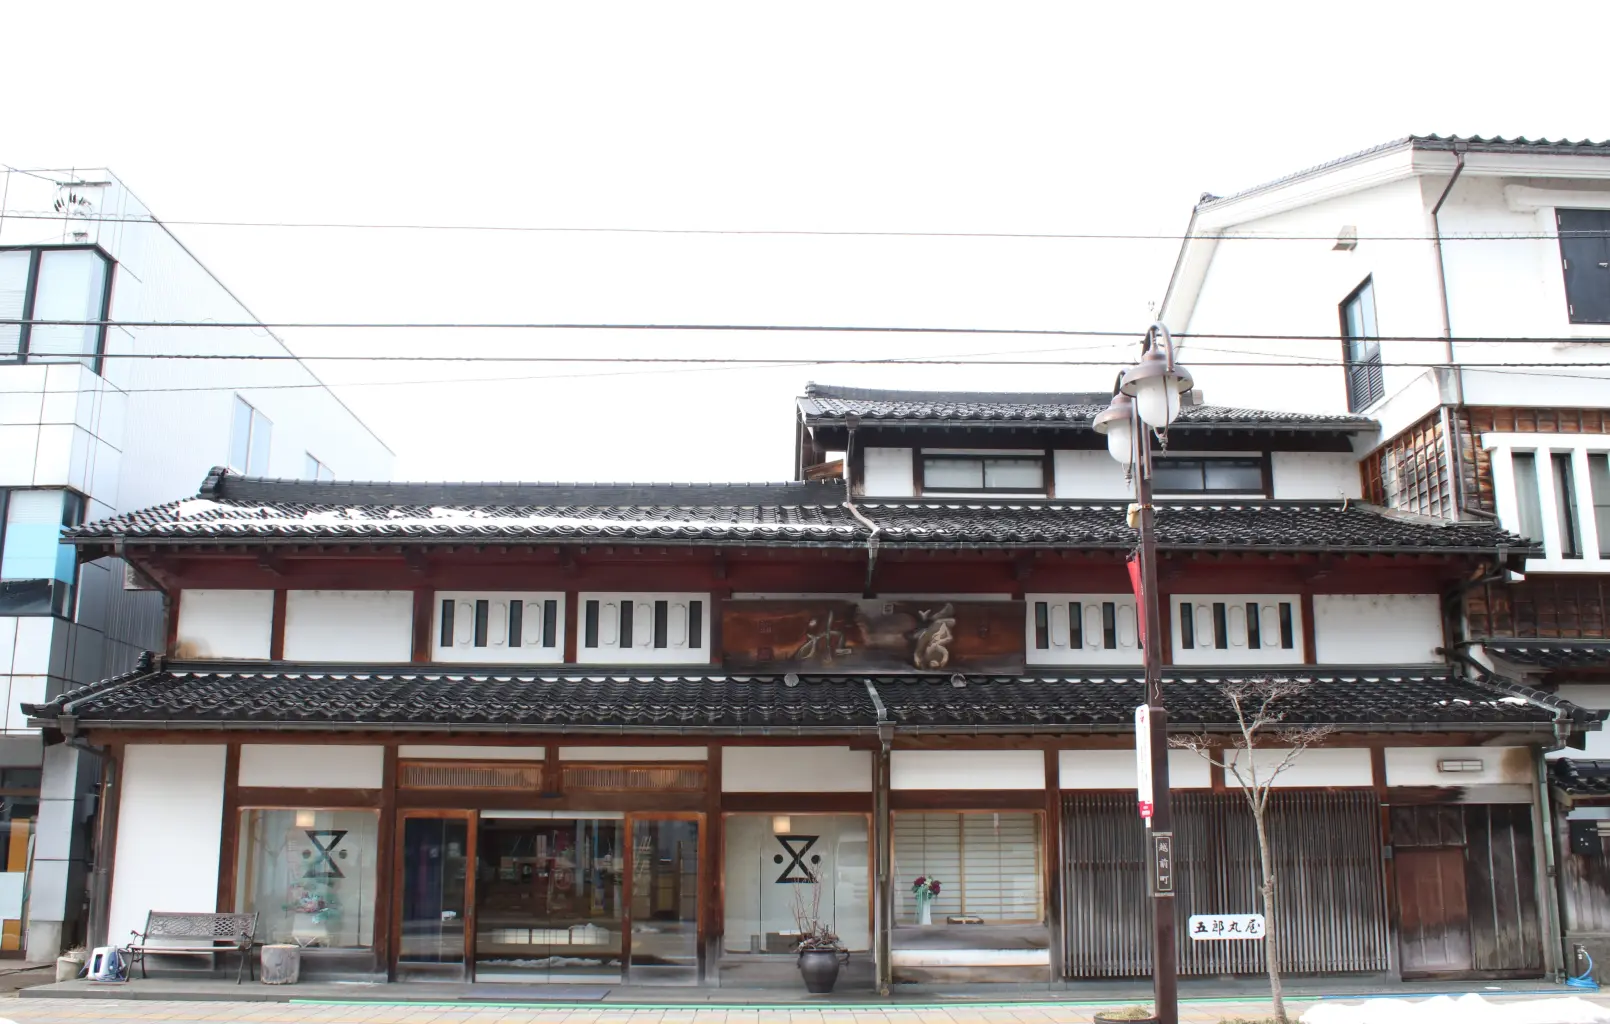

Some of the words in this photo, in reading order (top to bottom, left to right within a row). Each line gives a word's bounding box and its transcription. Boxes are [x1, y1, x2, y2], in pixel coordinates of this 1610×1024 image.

[1158, 842, 1169, 885] 越前町
[1194, 919, 1261, 936] 五郎丸屋
